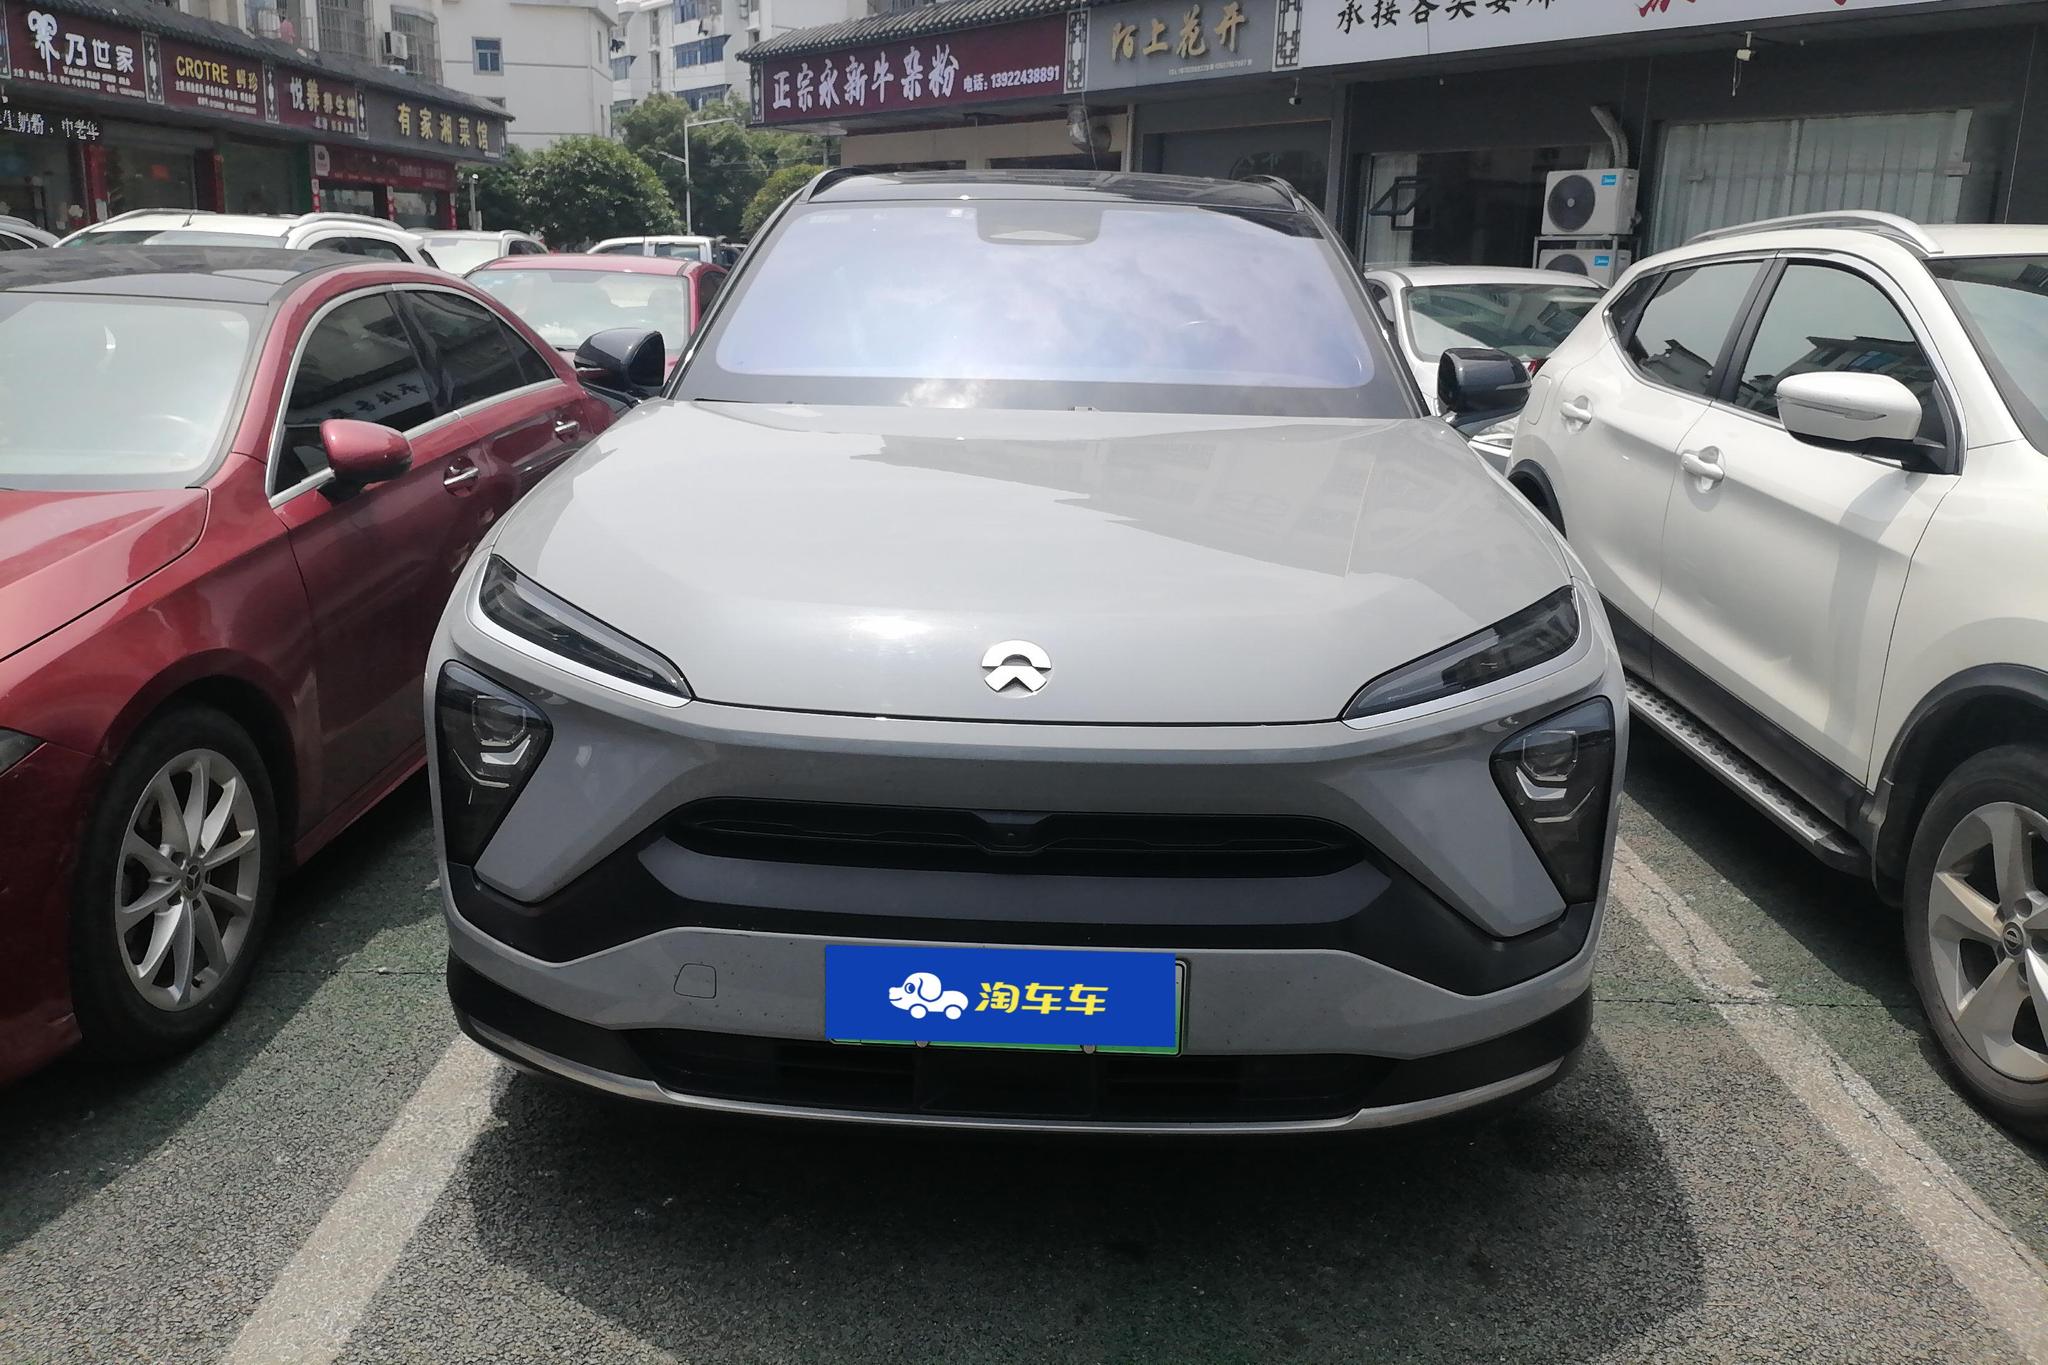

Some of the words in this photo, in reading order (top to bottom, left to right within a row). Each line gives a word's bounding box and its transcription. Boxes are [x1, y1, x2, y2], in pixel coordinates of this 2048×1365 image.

[1110, 2, 1246, 62] 陌上花开
[176, 55, 229, 85] CROTRE
[772, 43, 960, 113] 正宗永新牛杂粉
[990, 65, 1060, 89] 13922438891
[397, 101, 489, 151] 有家湘菜馆
